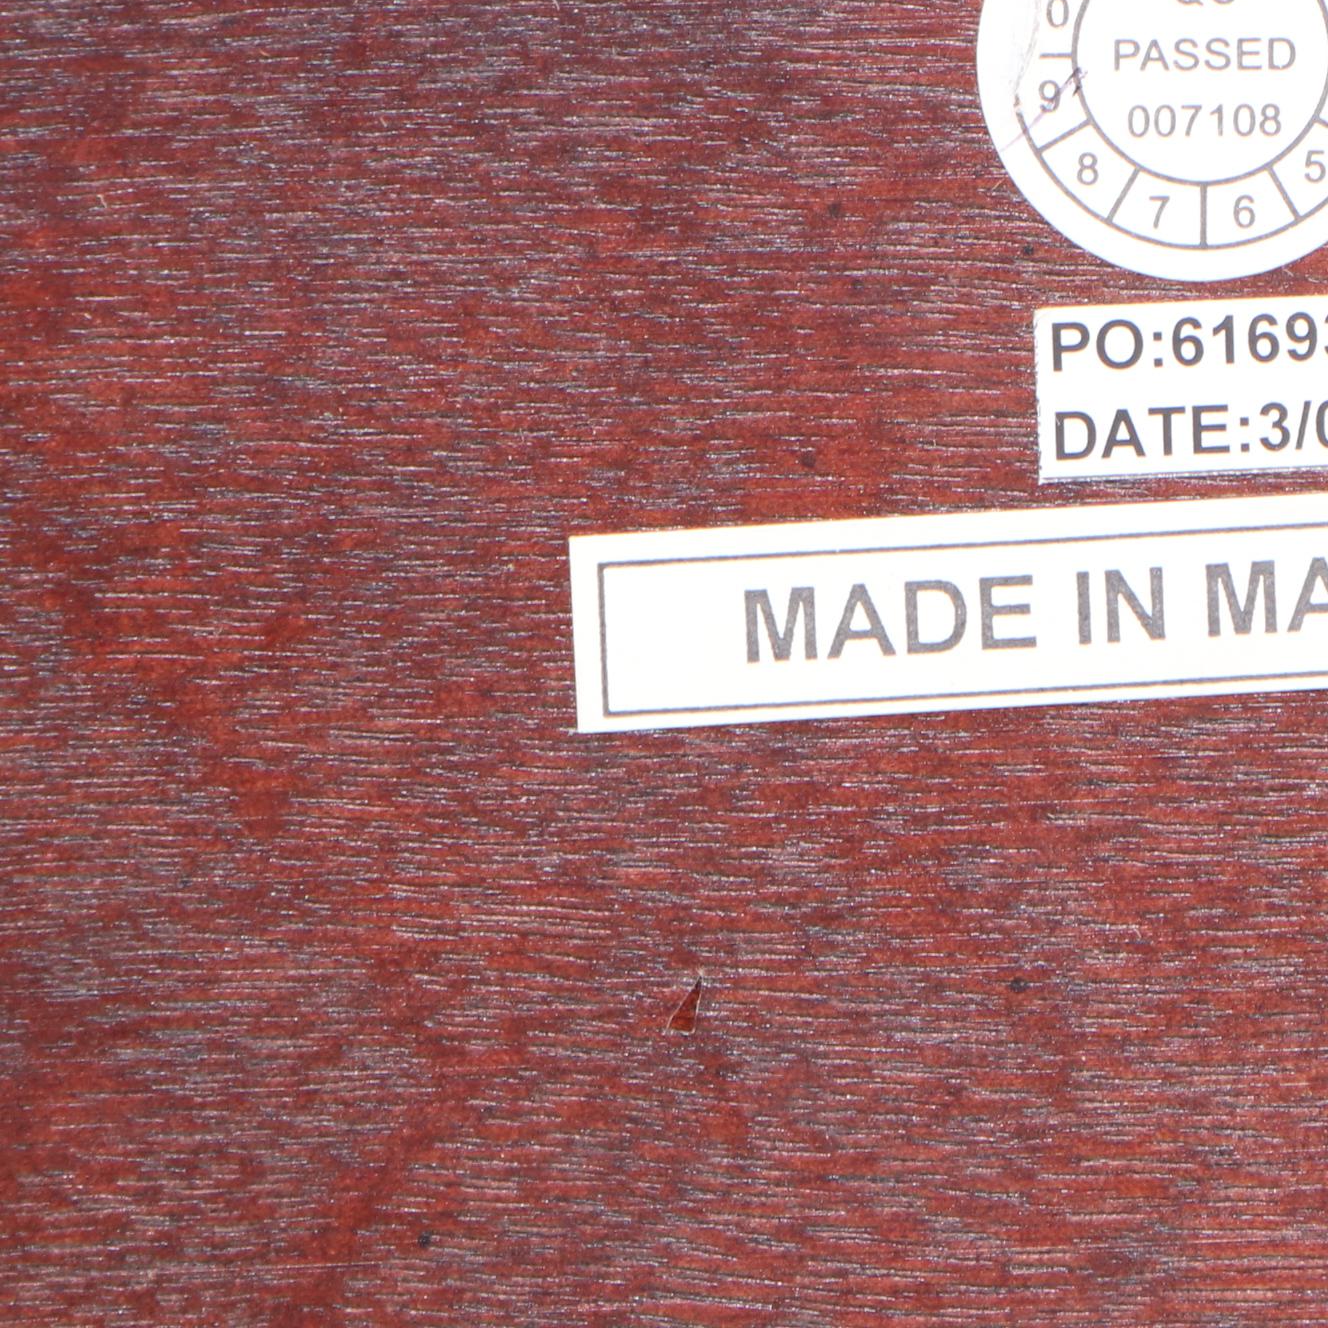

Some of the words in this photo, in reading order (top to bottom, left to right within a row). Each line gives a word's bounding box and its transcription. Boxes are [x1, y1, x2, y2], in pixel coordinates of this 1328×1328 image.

[1113, 37, 1297, 72] PASSED
[1037, 79, 1061, 113] 9
[1127, 103, 1282, 137] 007108
[1076, 152, 1099, 185] 8
[1304, 150, 1327, 183] 5
[1149, 196, 1171, 229] 7
[1232, 195, 1256, 228] 6
[744, 574, 1034, 666] MADE
[1076, 565, 1168, 644] IN
